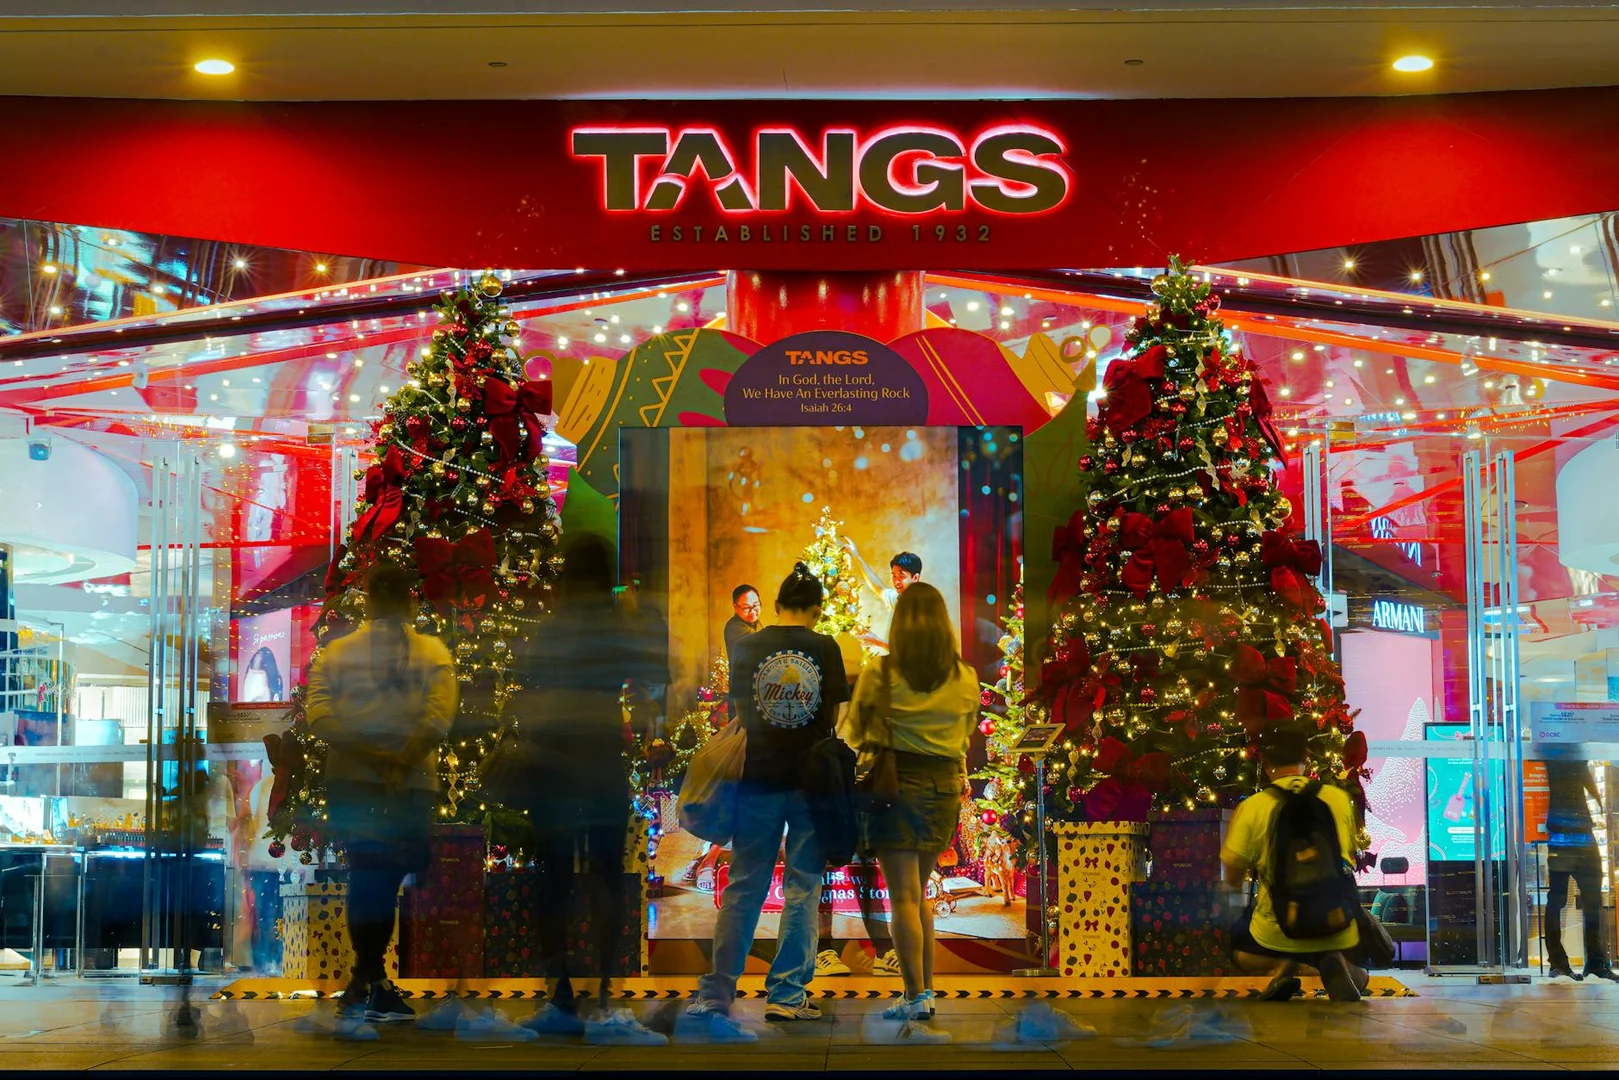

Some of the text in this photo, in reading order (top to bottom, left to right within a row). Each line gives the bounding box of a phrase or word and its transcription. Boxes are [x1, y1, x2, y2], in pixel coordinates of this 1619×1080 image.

[573, 130, 1068, 213] TANGS
[650, 225, 990, 242] ESTABLISHED 1932
[785, 350, 869, 365] TANGS
[778, 374, 875, 386] In God, the Lord,
[743, 387, 910, 401] We Have An Everlasting Rock
[801, 403, 852, 413] Isaiah 26:4
[1372, 600, 1425, 634] ARMANI
[765, 683, 814, 706] Mickey
